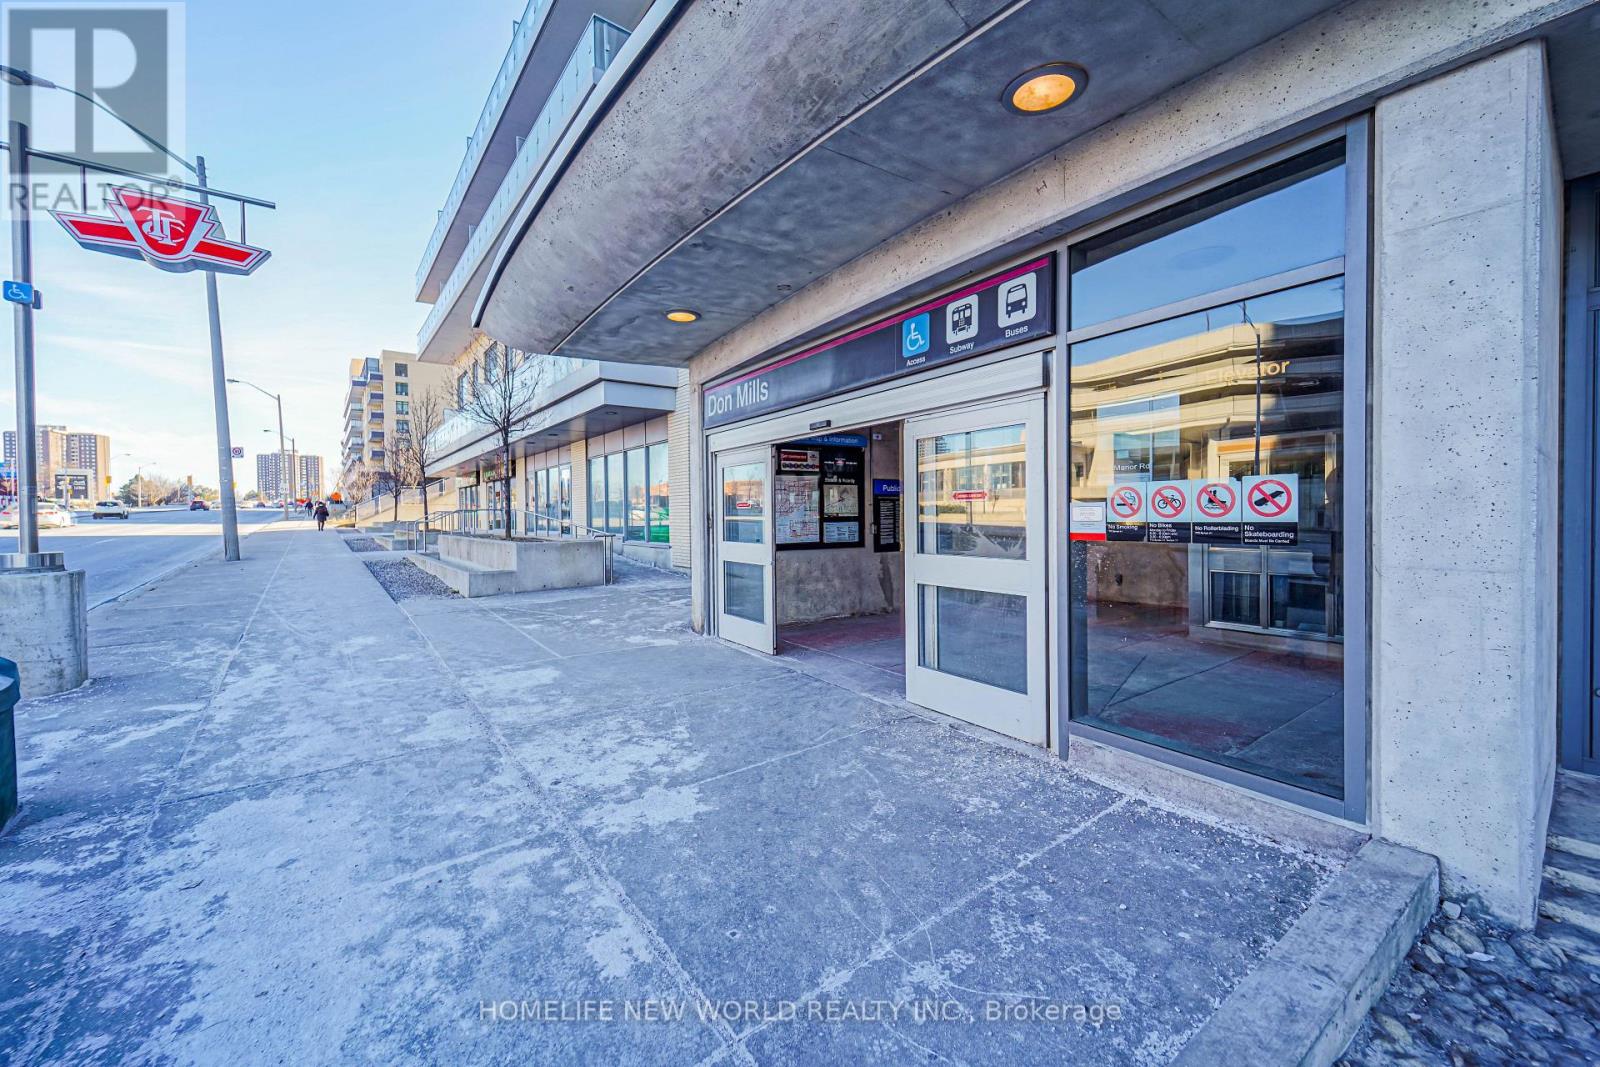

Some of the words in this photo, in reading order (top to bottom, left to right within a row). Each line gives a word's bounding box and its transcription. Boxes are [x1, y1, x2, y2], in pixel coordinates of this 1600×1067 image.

[1004, 324, 1029, 338] Buses
[949, 341, 975, 355] Subway
[906, 355, 926, 367] Access
[708, 393, 733, 417] Don
[736, 378, 769, 409] Mills
[882, 484, 901, 492] Public
[1244, 531, 1295, 539] Skateboarding
